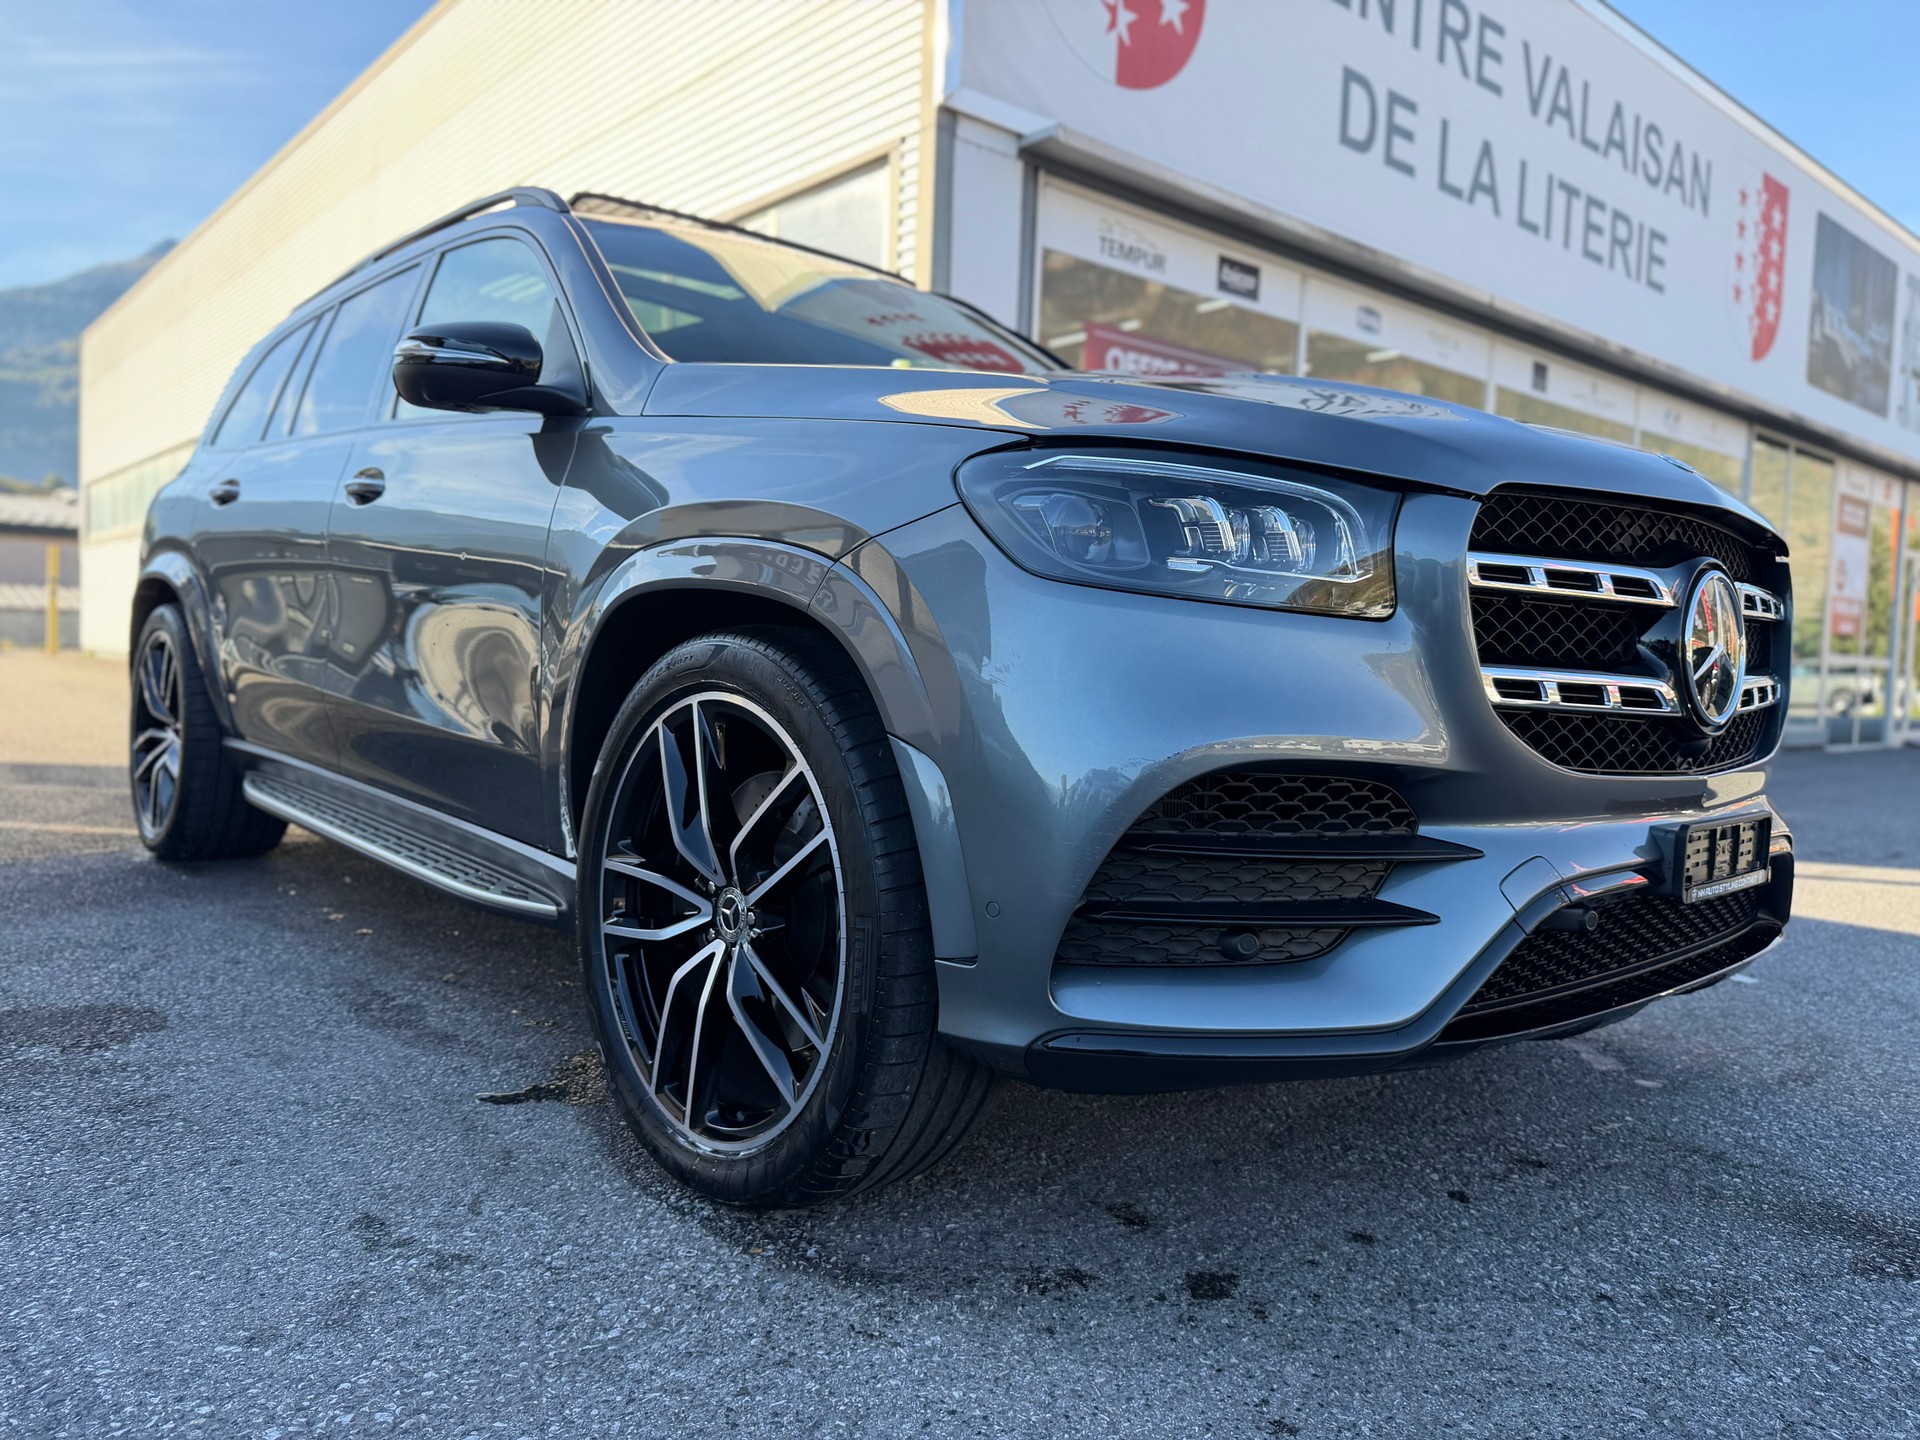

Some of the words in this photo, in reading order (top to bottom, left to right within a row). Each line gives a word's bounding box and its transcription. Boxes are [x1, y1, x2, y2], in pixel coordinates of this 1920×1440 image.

[1330, 0, 1507, 99] TRE
[1522, 38, 1712, 219] VALAISAN
[1338, 64, 1419, 179] DE
[1437, 116, 1501, 218] LA
[1516, 158, 1668, 295] LITERIE
[1098, 235, 1167, 274] TEMPUR
